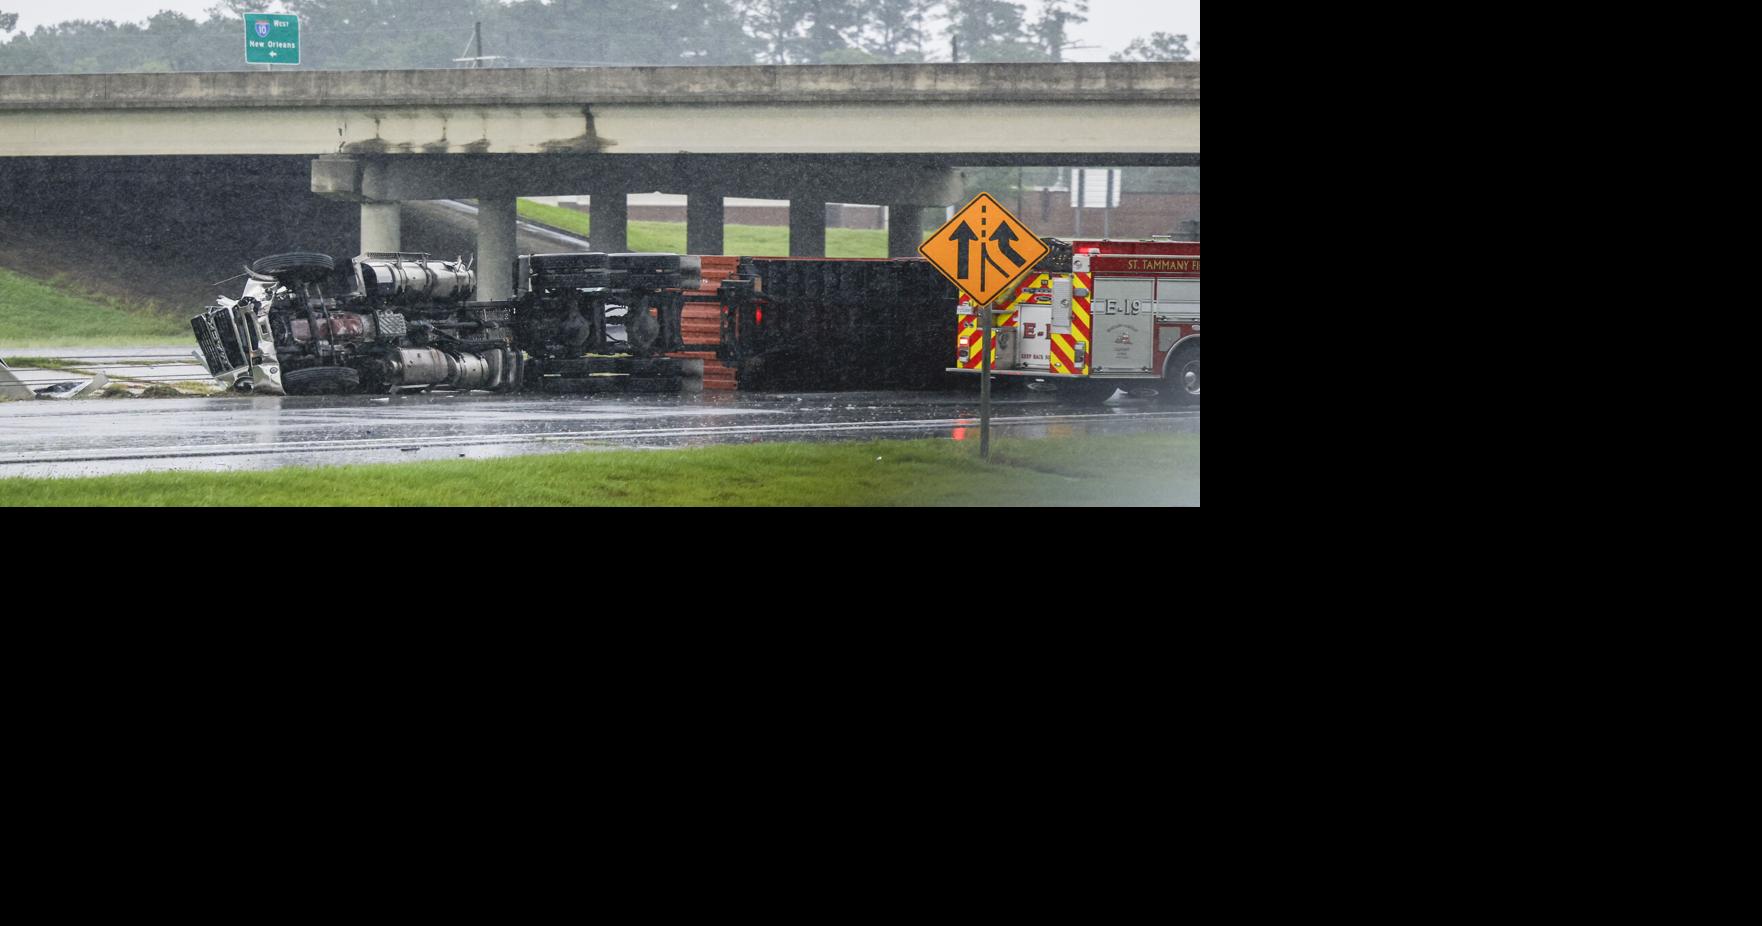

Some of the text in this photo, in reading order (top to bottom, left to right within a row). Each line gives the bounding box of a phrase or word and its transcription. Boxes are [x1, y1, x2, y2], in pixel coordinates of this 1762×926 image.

[258, 25, 267, 34] 10
[1128, 260, 1200, 270] ST. TAMMANY FI
[1105, 299, 1140, 315] E-19
[1023, 322, 1051, 339] E-1
